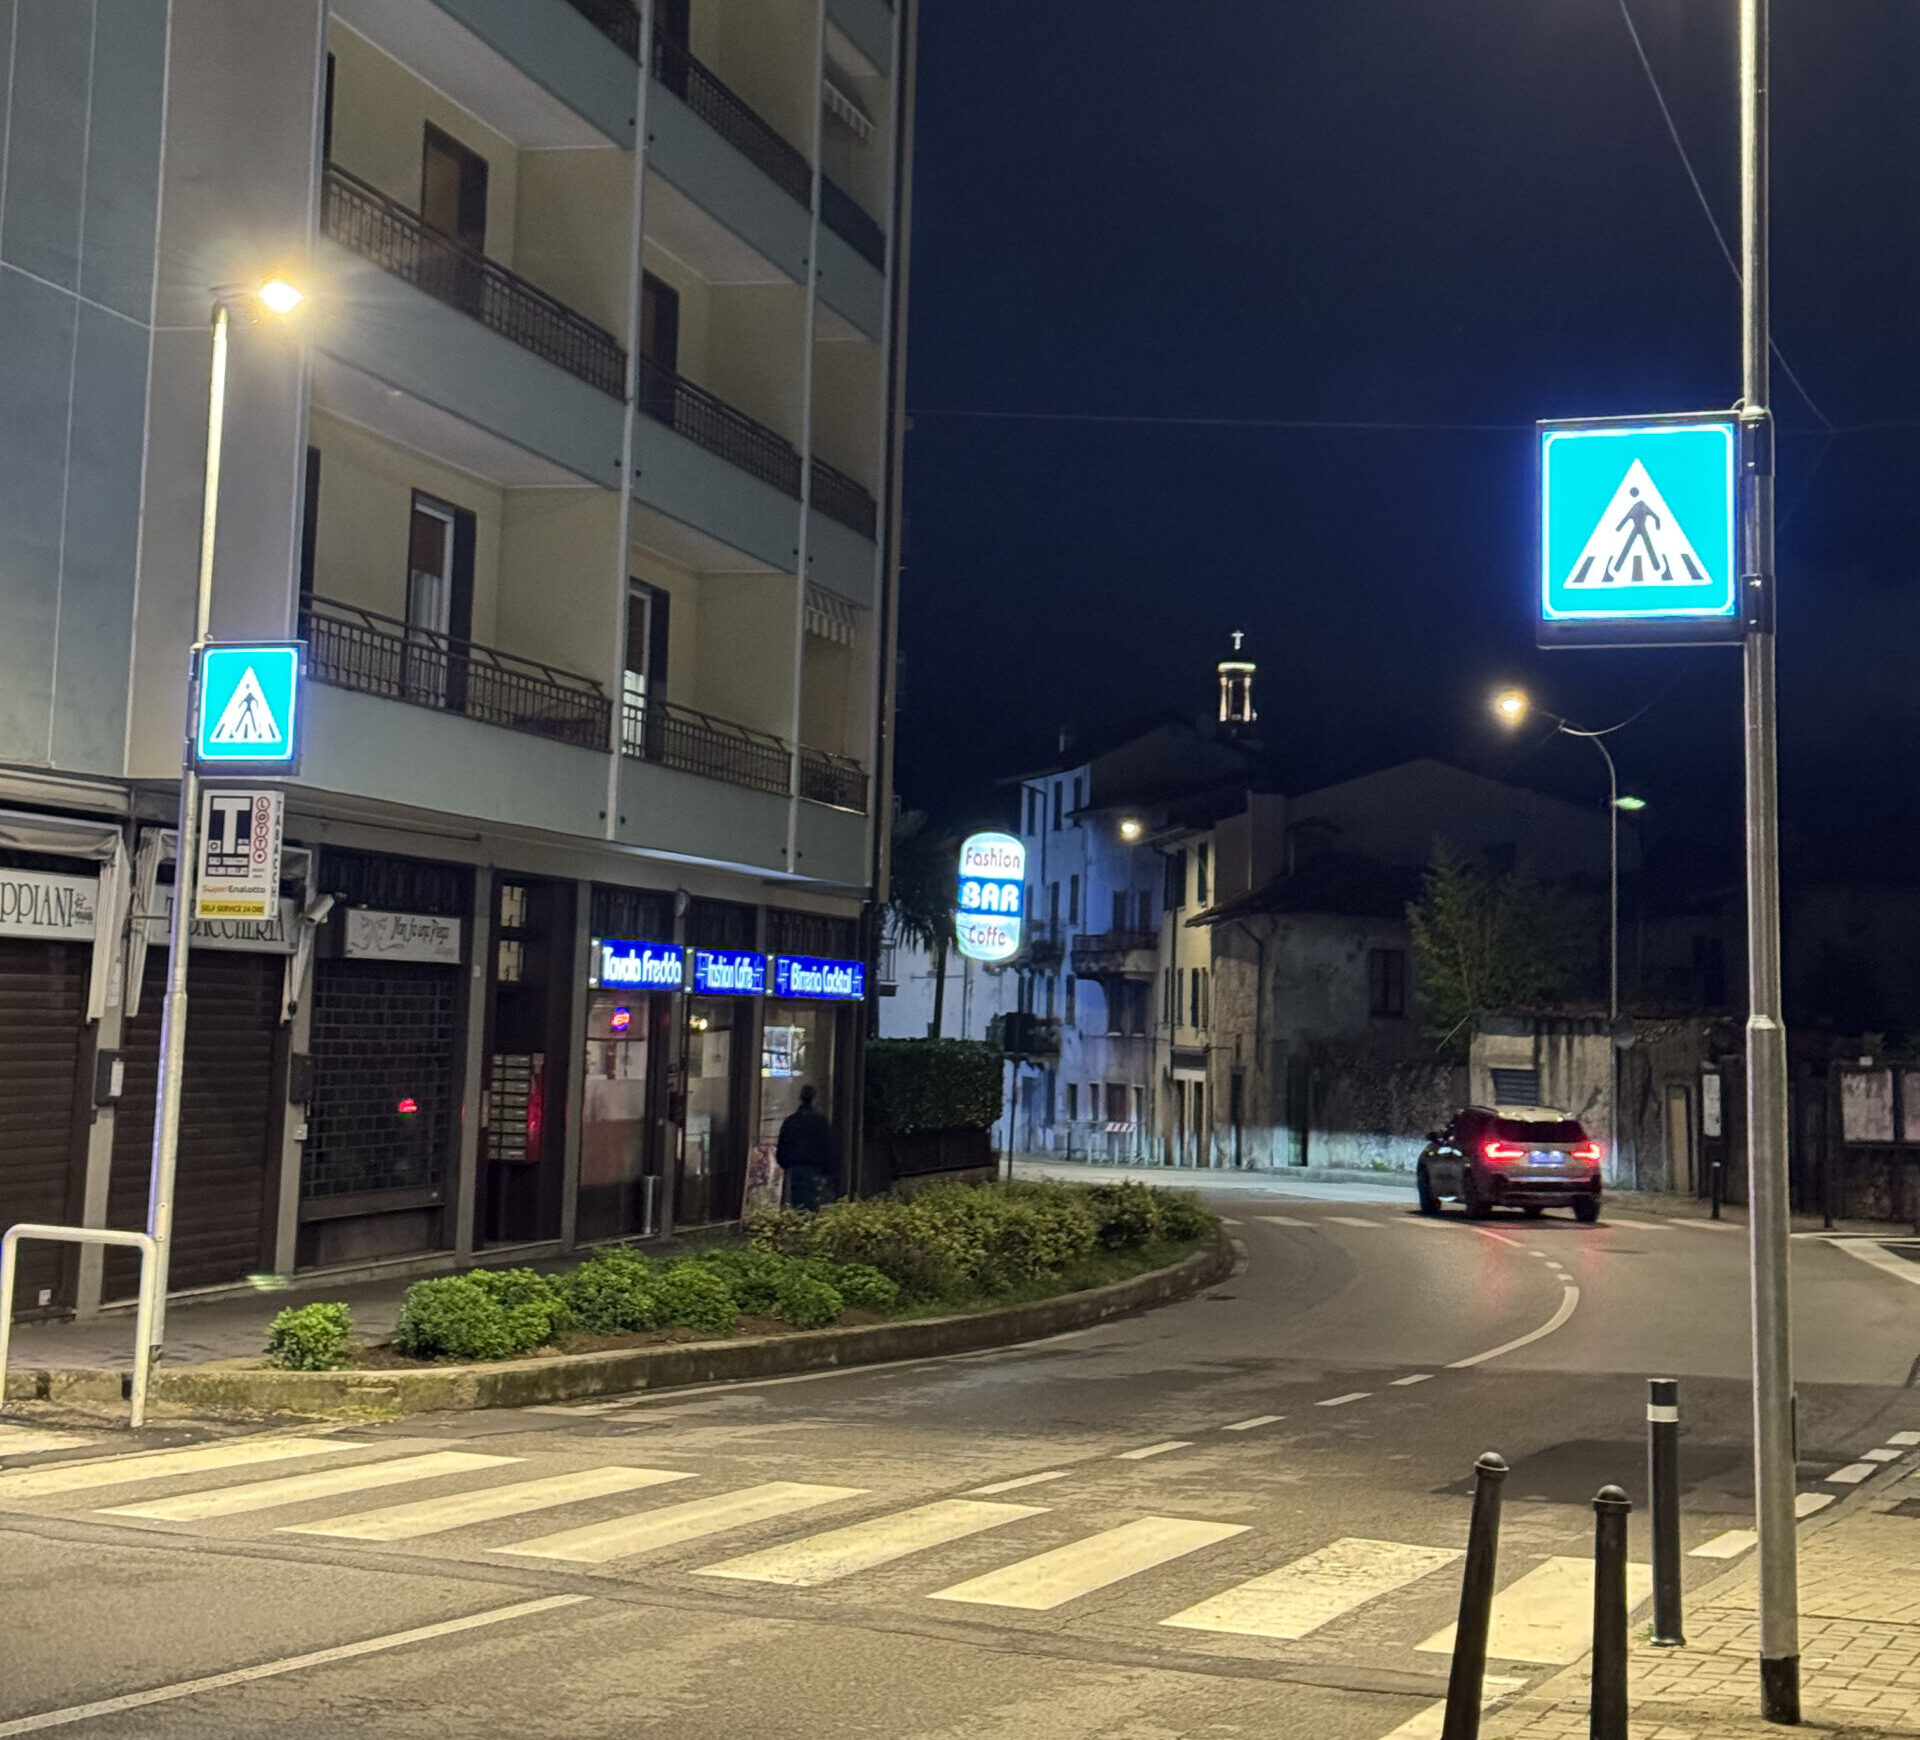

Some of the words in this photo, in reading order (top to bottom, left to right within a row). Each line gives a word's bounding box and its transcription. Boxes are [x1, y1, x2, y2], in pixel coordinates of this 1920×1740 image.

[253, 796, 270, 864] LOTTO
[270, 799, 283, 913] TABACCHI
[966, 846, 1020, 869] Fashion
[201, 904, 215, 913] SELF
[217, 904, 241, 913] SERVICE
[243, 904, 251, 913] 24
[252, 904, 265, 914] ORE
[962, 880, 1020, 913] BAR
[968, 925, 1006, 947] Coffe
[602, 946, 641, 982] Tavola
[790, 962, 822, 993] Birreria
[823, 965, 852, 993] Cocktail
